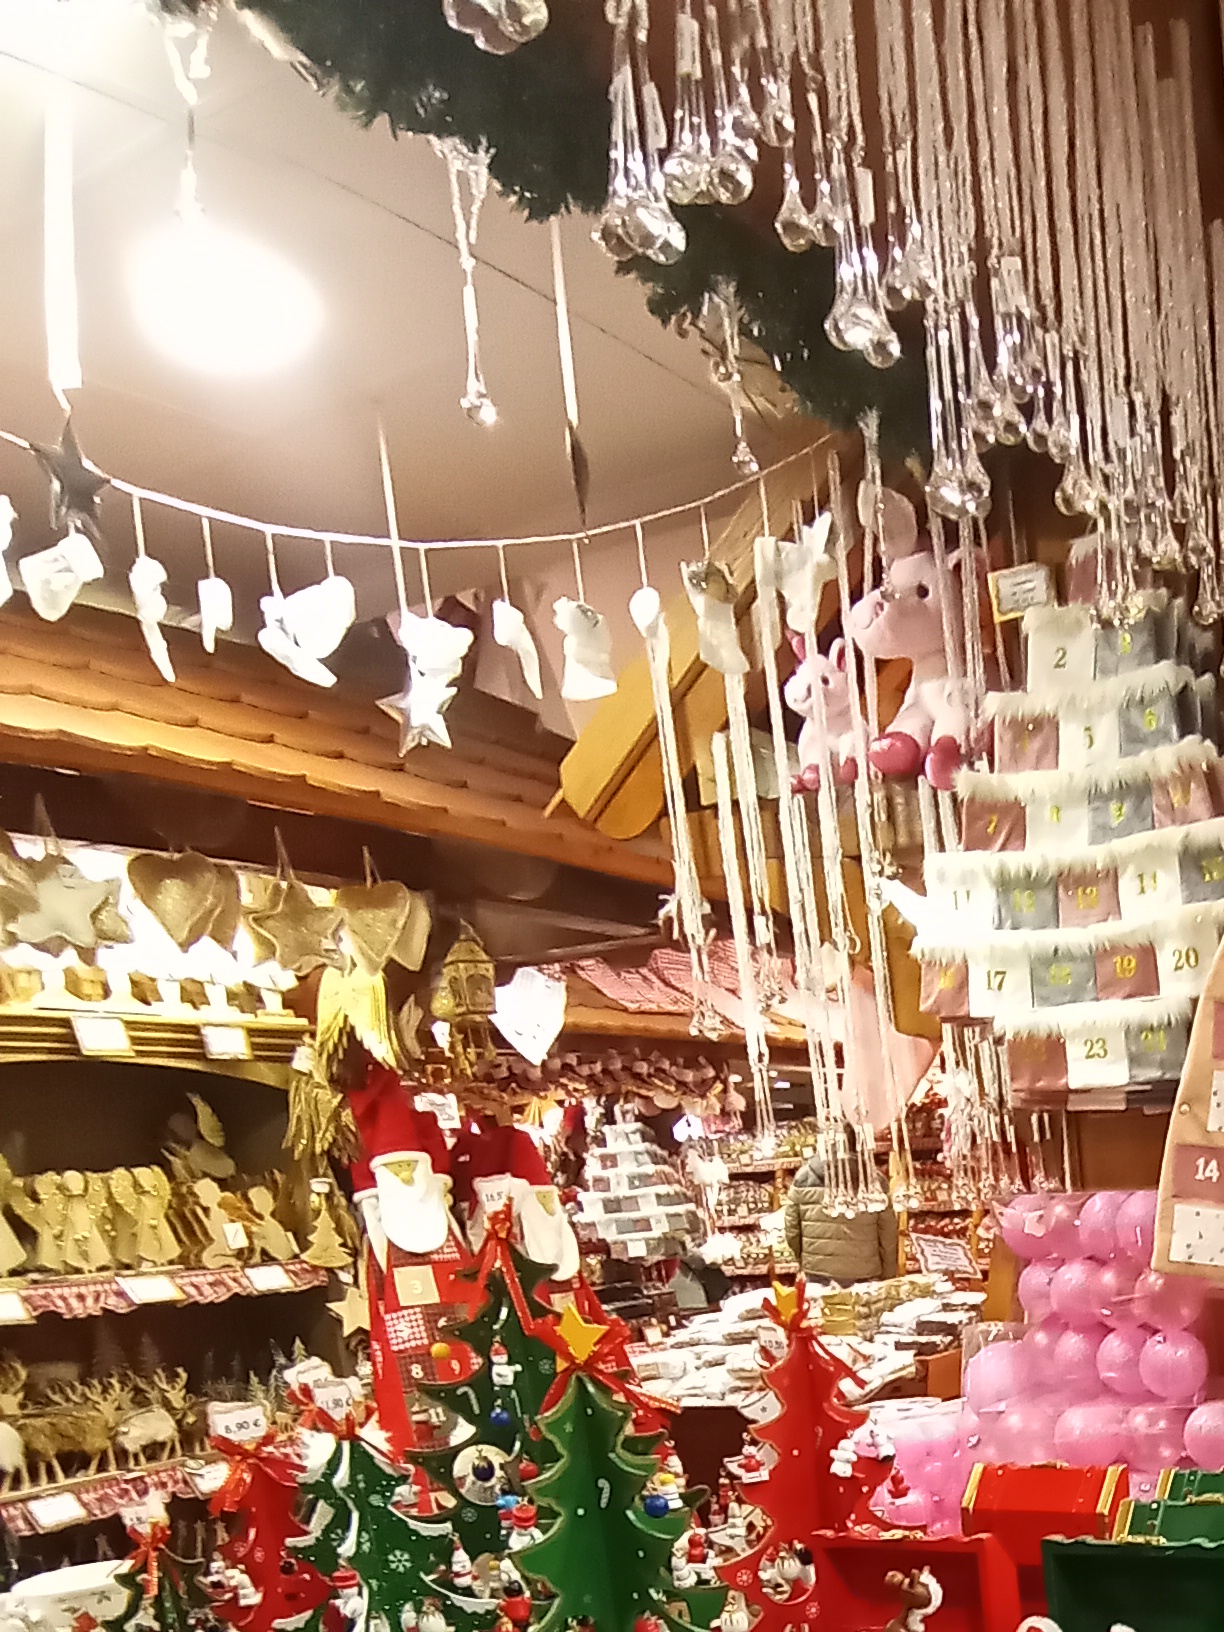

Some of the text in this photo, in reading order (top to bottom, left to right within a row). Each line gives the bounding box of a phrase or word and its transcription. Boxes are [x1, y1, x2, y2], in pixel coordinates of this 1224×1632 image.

[1053, 648, 1067, 670] 2
[1172, 947, 1200, 972] 20
[985, 969, 1008, 992] 17
[1084, 1037, 1108, 1059] 23
[1194, 1157, 1220, 1183] 14
[410, 1280, 422, 1294] 3
[411, 1364, 424, 1378] 8
[450, 1360, 461, 1375] 9
[252, 1418, 261, 1428] €
